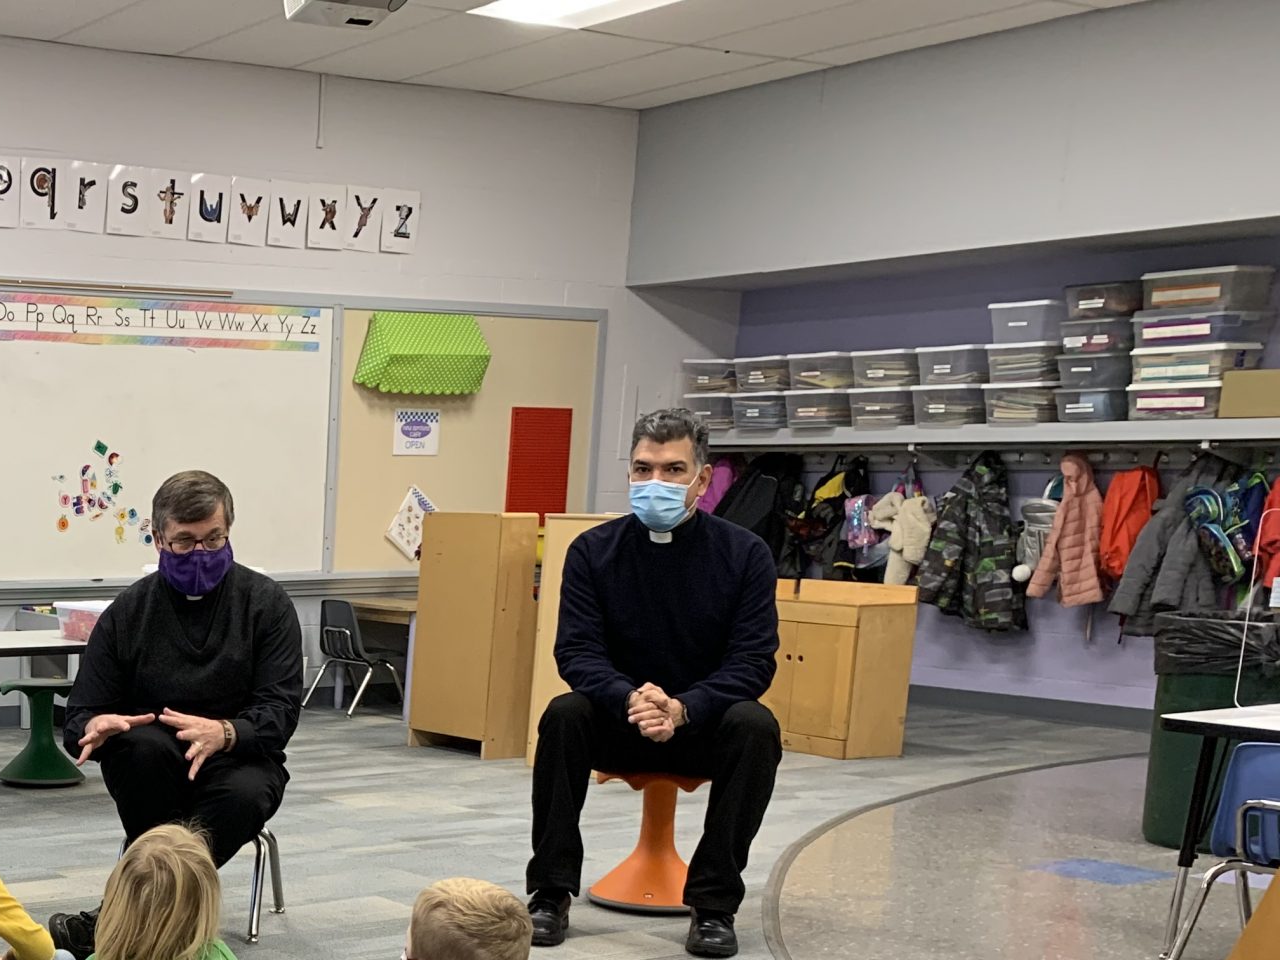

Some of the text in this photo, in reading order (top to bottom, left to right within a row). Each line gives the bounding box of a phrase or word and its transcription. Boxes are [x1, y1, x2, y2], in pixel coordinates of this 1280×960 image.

[29, 161, 58, 220] q
[80, 177, 97, 209] r
[121, 181, 139, 214] s
[160, 179, 185, 225] t
[199, 190, 223, 223] u
[240, 195, 263, 223] v
[279, 198, 301, 228] w
[319, 198, 337, 231] x
[353, 195, 378, 238] y
[393, 204, 411, 238] z
[26, 303, 45, 331] Pp
[52, 305, 78, 333] Qq
[86, 306, 103, 326] Rr
[115, 307, 130, 327] Ss
[139, 309, 156, 328] Tt
[166, 310, 186, 329] Uu
[195, 311, 213, 329] Vv
[219, 312, 245, 331] Ww
[250, 313, 269, 333] Xx
[277, 315, 294, 342] Yy
[301, 316, 316, 334] Zz
[405, 441, 425, 449] OPEN
